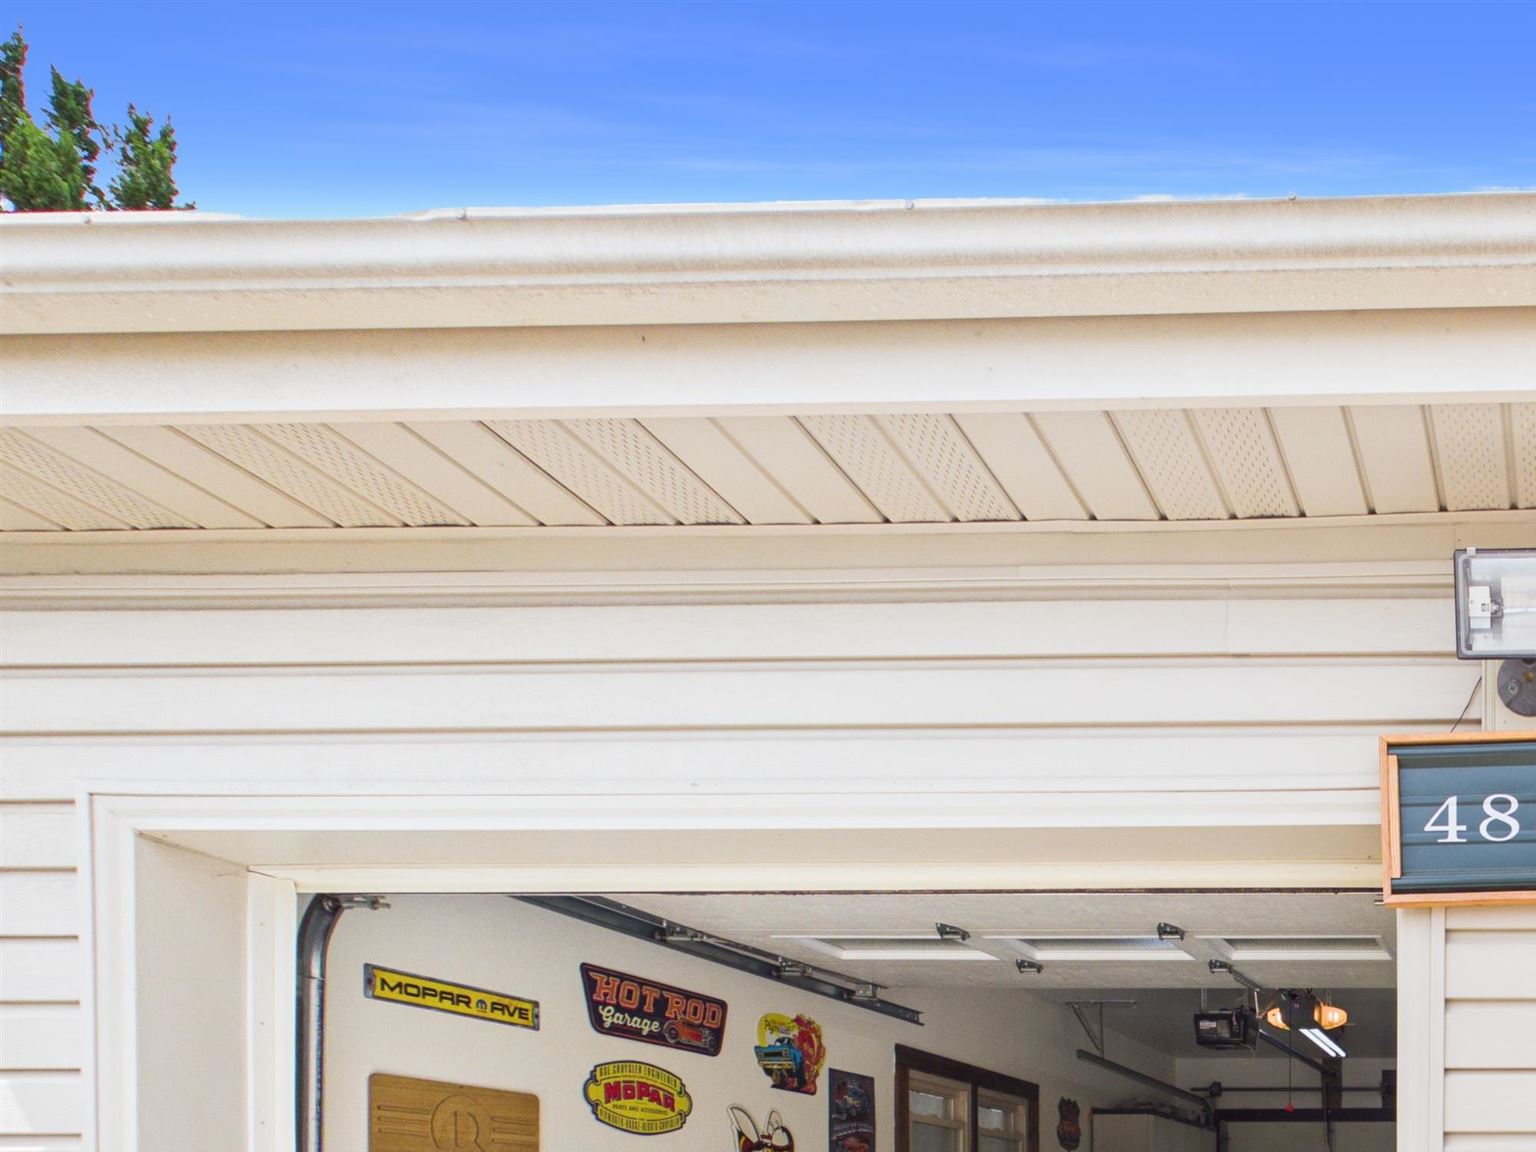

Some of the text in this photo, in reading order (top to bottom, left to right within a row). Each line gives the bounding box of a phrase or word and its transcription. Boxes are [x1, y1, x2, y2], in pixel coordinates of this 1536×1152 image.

[380, 977, 530, 1021] MOPAR AVE
[588, 971, 660, 1014] HOT
[661, 990, 722, 1028] ROD
[598, 1005, 661, 1036] Garage
